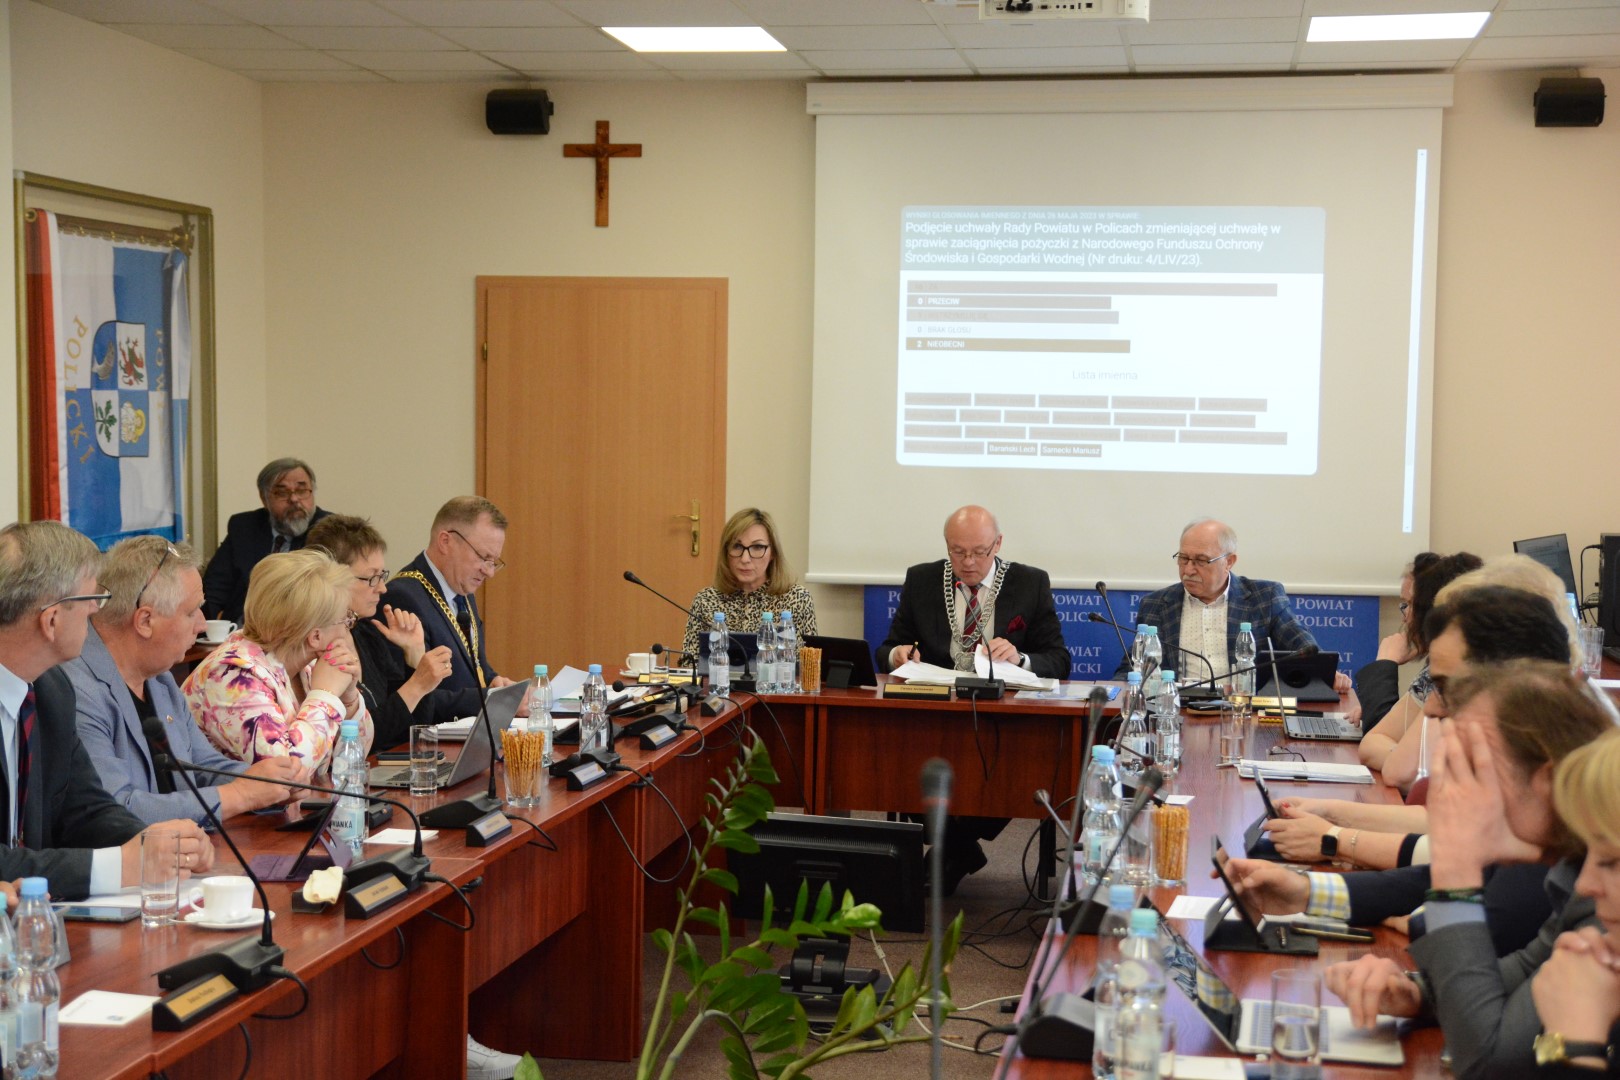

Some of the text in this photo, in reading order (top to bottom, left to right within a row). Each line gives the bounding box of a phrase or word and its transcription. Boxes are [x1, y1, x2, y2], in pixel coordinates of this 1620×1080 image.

[905, 222, 1281, 236] Podjęcie uchwały Rady Powiatu w Policach zmieniającej uchwałę w
[905, 237, 1264, 252] sprawie zaciągnięcia pożyczki z Narodowego Funduszu Ochrony
[904, 250, 969, 264] Środowiska
[977, 252, 1040, 266] Gospodarki
[1043, 253, 1085, 266] Wodnej
[1087, 253, 1106, 266] (Nr
[1108, 253, 1144, 265] druku:
[1145, 254, 1203, 267] 4/LIV/23).
[917, 297, 960, 305] 0 PRZECIW
[917, 340, 965, 348] 2 NIEOBECNI
[1072, 370, 1138, 380] Lista imienna
[1019, 445, 1036, 454] Lech
[1042, 445, 1100, 455] Sarnecki Mariusz
[1295, 597, 1354, 611] POWIAT
[1056, 611, 1103, 622] OLIC
[1295, 614, 1354, 628] POLICKI
[1066, 646, 1102, 657] WIAT
[1070, 662, 1102, 674] ICKI
